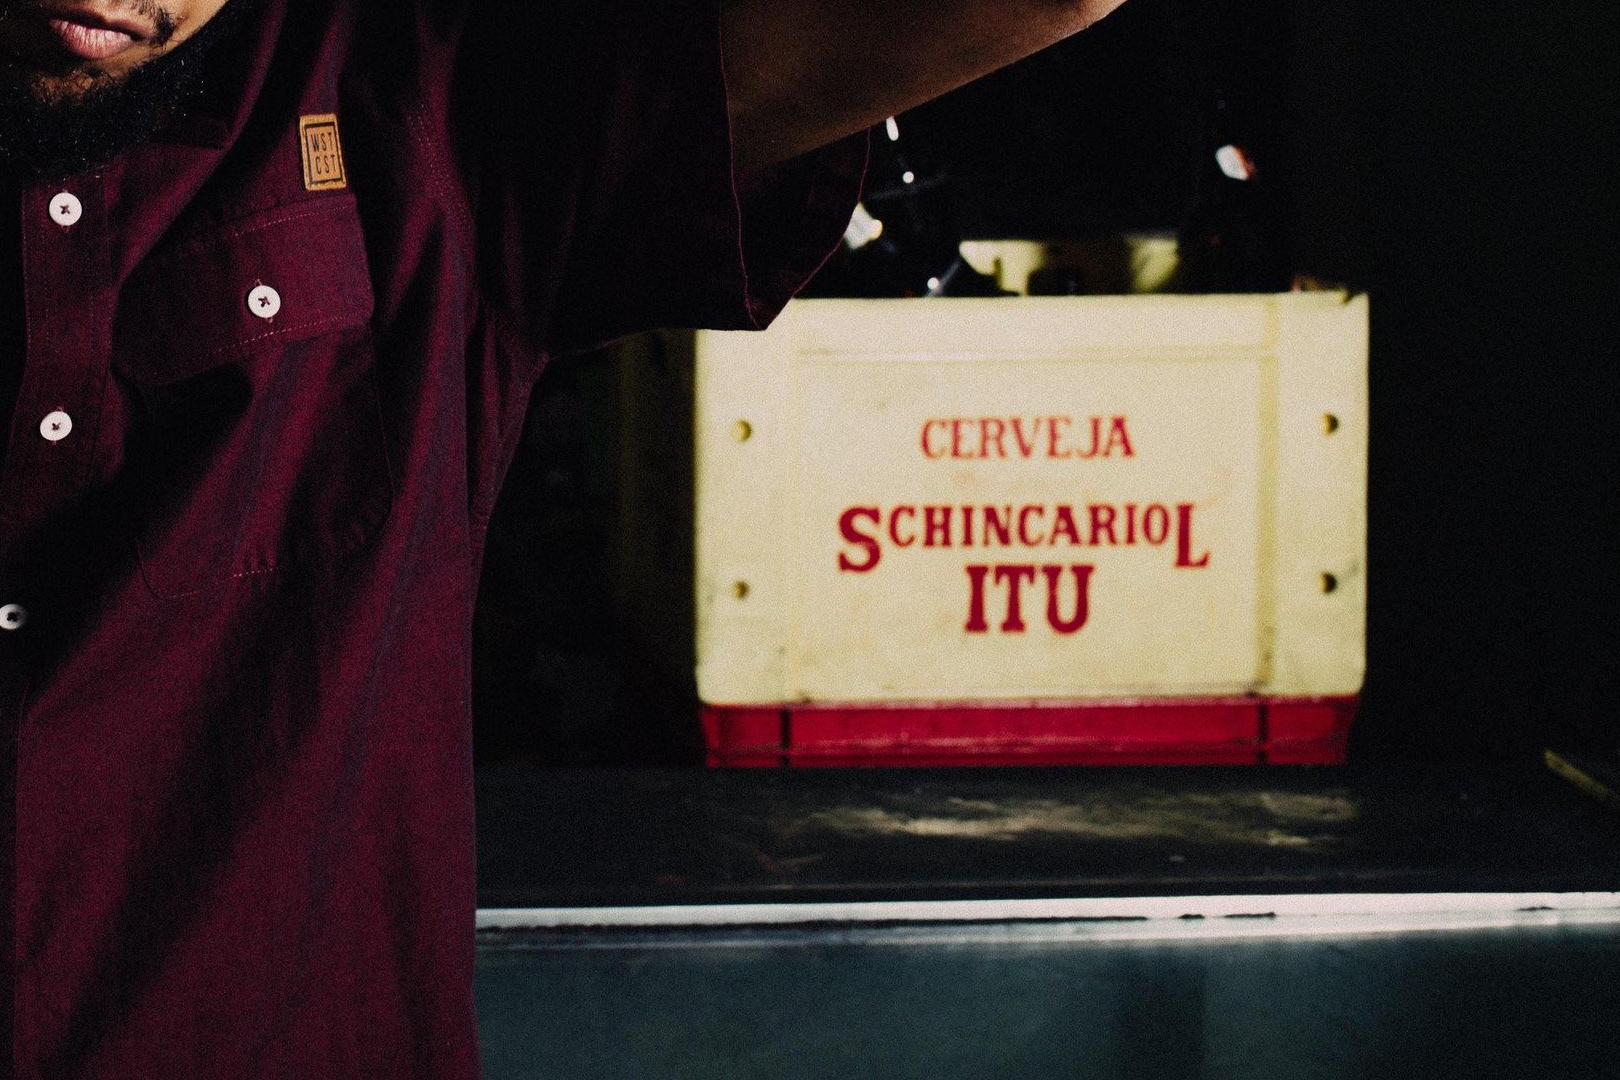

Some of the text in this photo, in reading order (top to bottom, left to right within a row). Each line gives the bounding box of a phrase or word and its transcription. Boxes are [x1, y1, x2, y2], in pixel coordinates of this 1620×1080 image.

[310, 132, 332, 152] WST
[315, 154, 336, 175] CST
[920, 416, 1136, 459] CERVEJA
[837, 503, 1212, 574] SCHINCARIOL
[964, 565, 1096, 635] ITU
